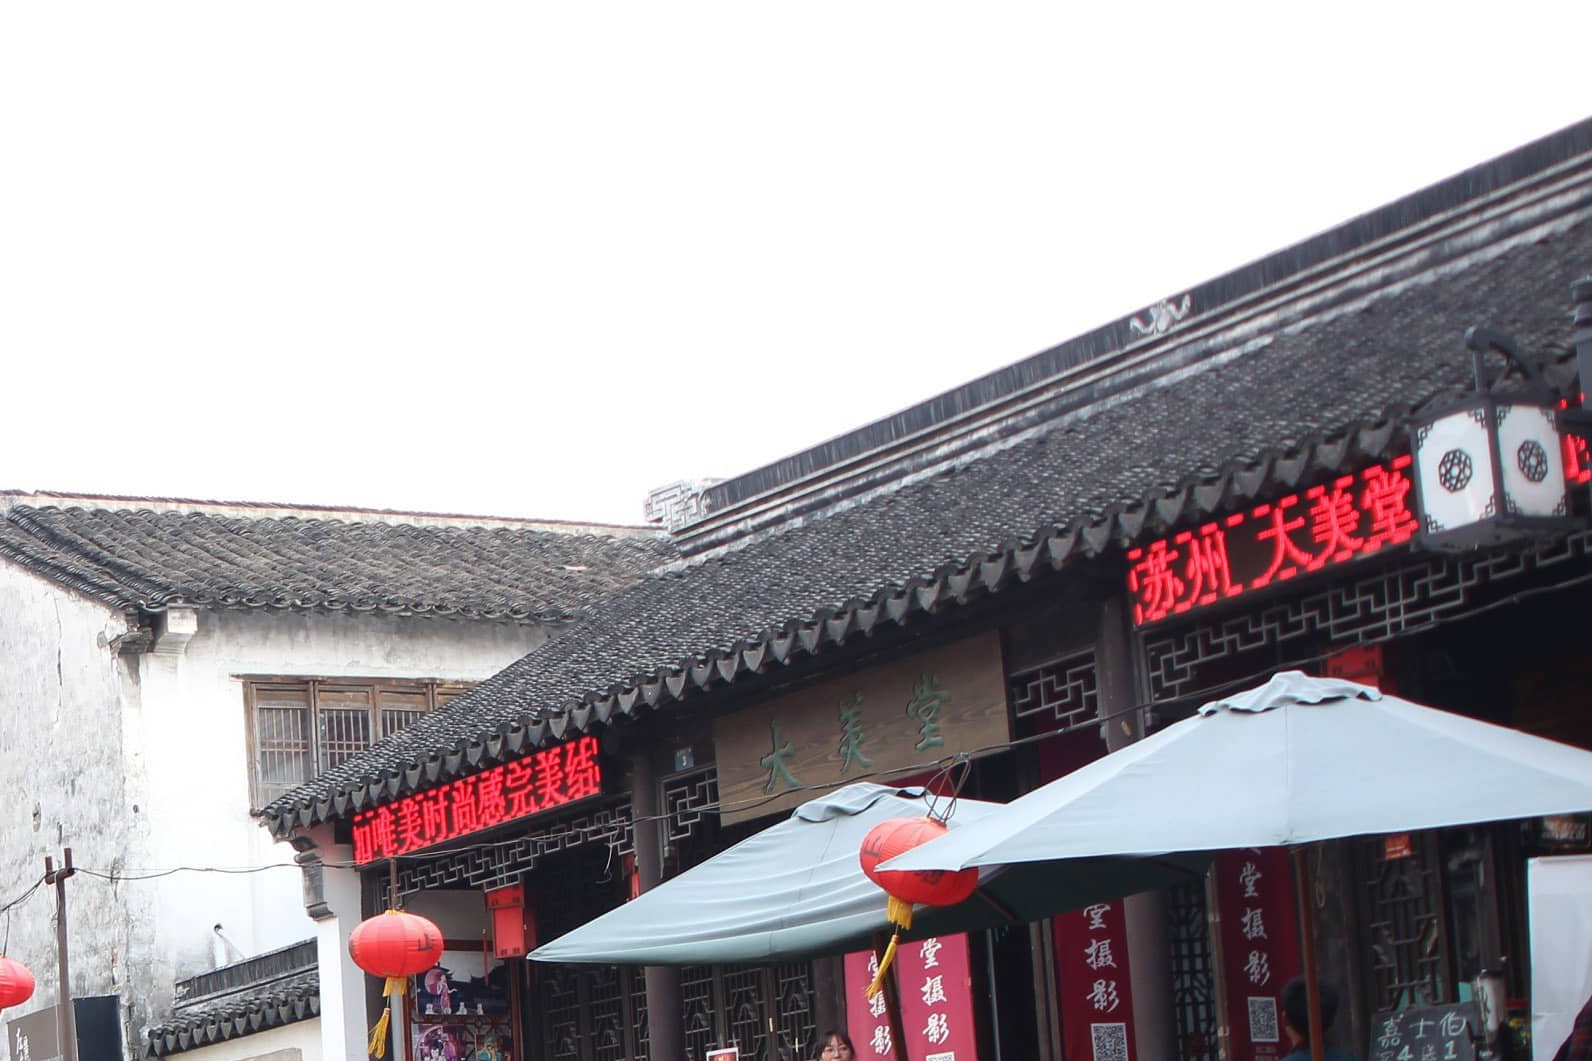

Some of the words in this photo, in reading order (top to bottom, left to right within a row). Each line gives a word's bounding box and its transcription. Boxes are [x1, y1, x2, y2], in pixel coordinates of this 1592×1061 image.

[760, 672, 953, 794] 大美堂
[1239, 848, 1270, 986] 堂摄影
[919, 937, 950, 1046] 堂摄影
[1377, 1011, 1467, 1049] 嘉士伯
